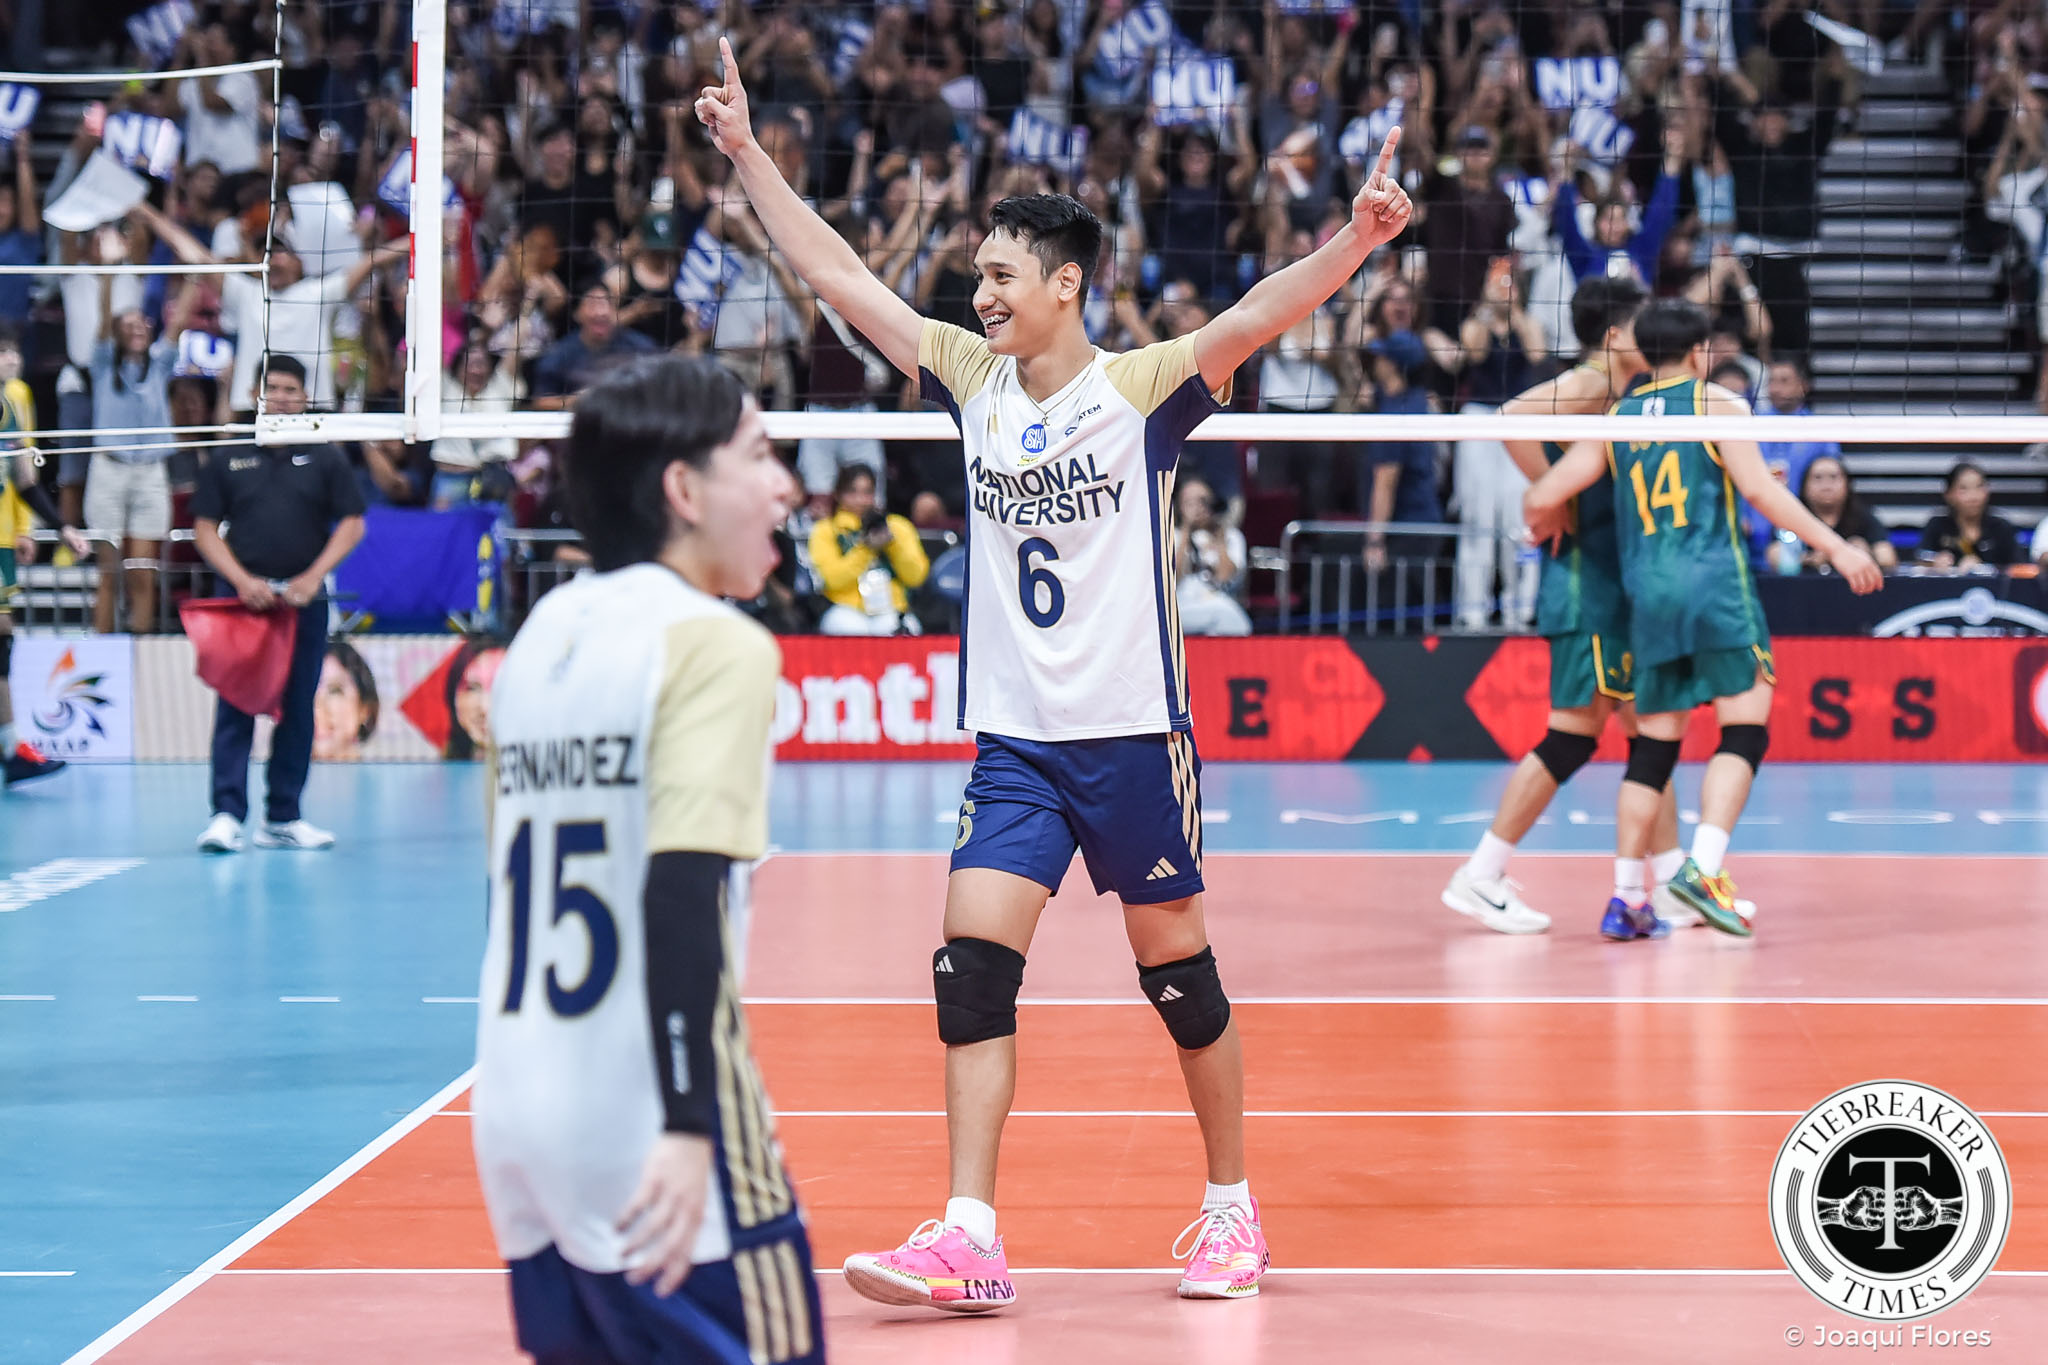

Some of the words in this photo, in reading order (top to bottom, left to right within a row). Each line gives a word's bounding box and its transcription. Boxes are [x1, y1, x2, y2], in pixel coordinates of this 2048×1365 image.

[1152, 58, 1234, 106] NU
[1537, 57, 1619, 100] NU
[674, 228, 722, 300] NU
[970, 454, 1109, 498] NATIONAL
[1629, 450, 1689, 536] 14
[1018, 537, 1065, 628] 6
[502, 818, 621, 1019] 15
